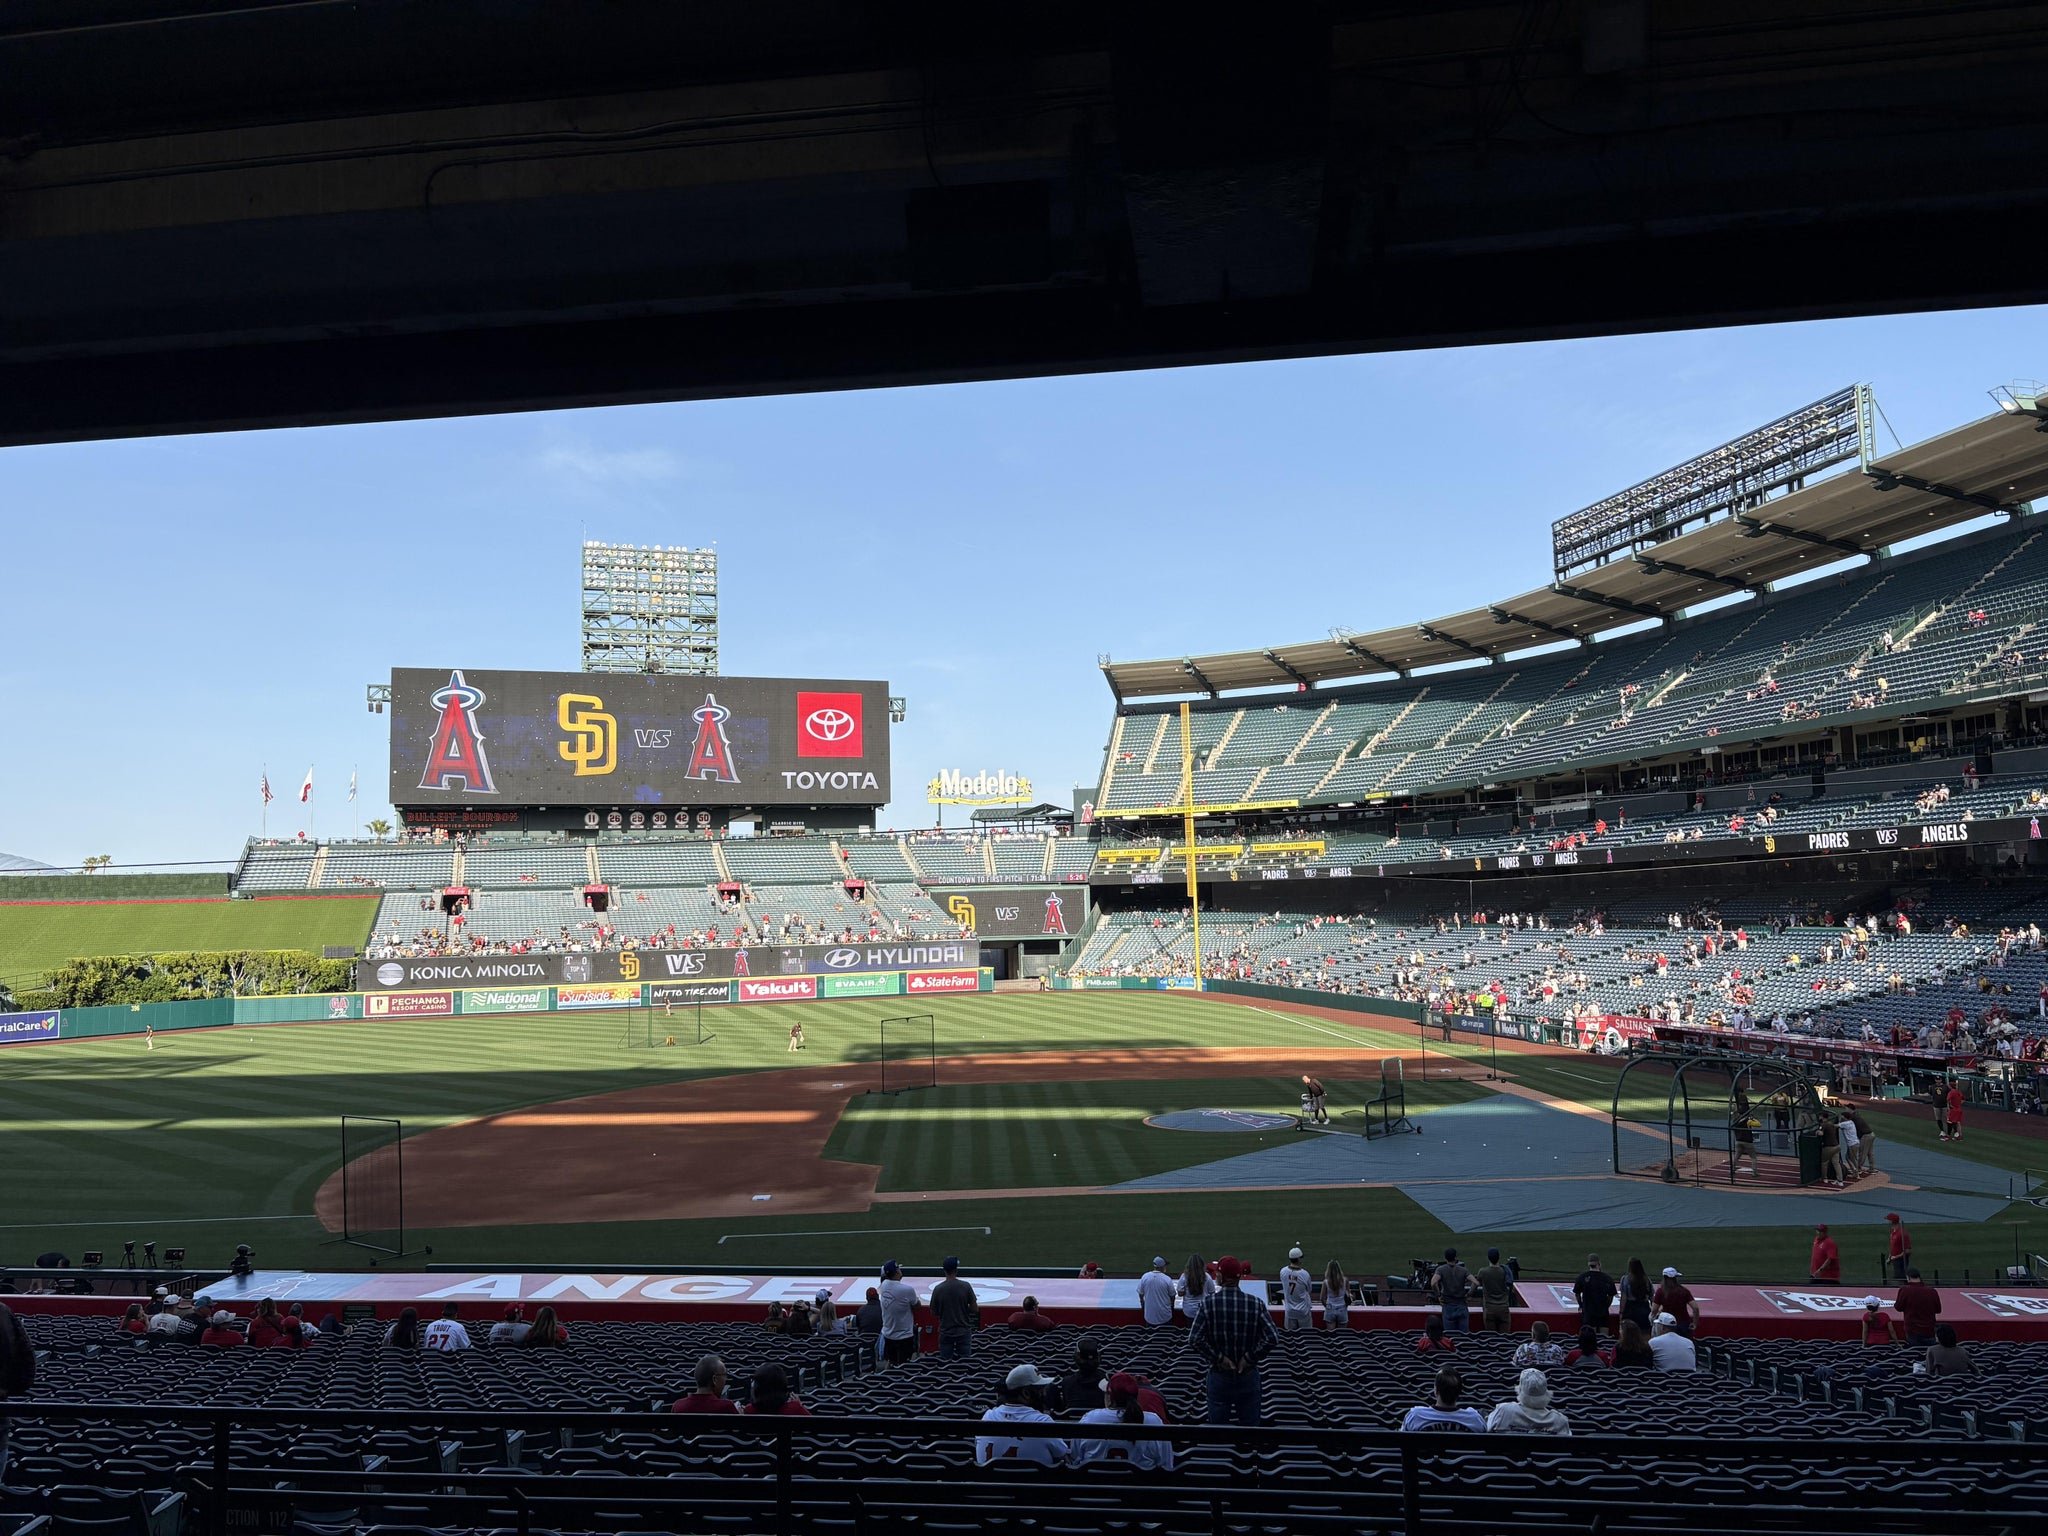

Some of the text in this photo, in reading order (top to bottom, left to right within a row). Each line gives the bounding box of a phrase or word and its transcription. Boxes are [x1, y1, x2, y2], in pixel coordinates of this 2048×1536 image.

[418, 670, 500, 794] A
[557, 693, 741, 784] SD VS A
[781, 770, 880, 791] TOYOTA
[940, 768, 1018, 795] Modelo
[406, 812, 519, 822] BULLEIT BOURBON
[588, 813, 596, 823] 11
[609, 814, 621, 823] 26
[631, 814, 643, 823] 29
[654, 814, 666, 823] 30
[677, 814, 688, 823] 42
[699, 814, 709, 823] 50
[1808, 831, 1850, 849] PADRES
[1876, 829, 1898, 845] VS
[1921, 823, 1968, 843] ANGELS
[1498, 856, 1520, 869] PADRES
[1532, 854, 1544, 866] VS
[1555, 852, 1578, 865] ANGELS
[938, 876, 976, 884] COUNTDOWN
[1004, 875, 1023, 883] PITCH
[1262, 869, 1289, 880] PADRES
[1304, 868, 1317, 878] VS
[1330, 867, 1352, 877] ANGELS
[995, 907, 1019, 921] VS
[867, 946, 964, 966] HYUNDAI
[410, 963, 545, 980] KONICA MINOLTA
[619, 951, 640, 981] SD
[665, 953, 706, 976] VS
[653, 986, 728, 998] NITTO TIRE.COM
[744, 981, 812, 996] Yakult
[391, 996, 447, 1006] PECHANGA
[486, 991, 541, 1005] National
[562, 989, 610, 1003] Surfside
[518, 1002, 538, 1010] Rental
[1501, 1022, 1519, 1036] Modelo
[1615, 1018, 1648, 1032] SALINAS
[1289, 1282, 1297, 1295] 7
[1798, 1296, 1857, 1308] '82
[433, 1324, 452, 1332] TROUT
[497, 1327, 513, 1336] TROUT
[428, 1334, 450, 1349] 27
[225, 1508, 288, 1528] CTION 112
